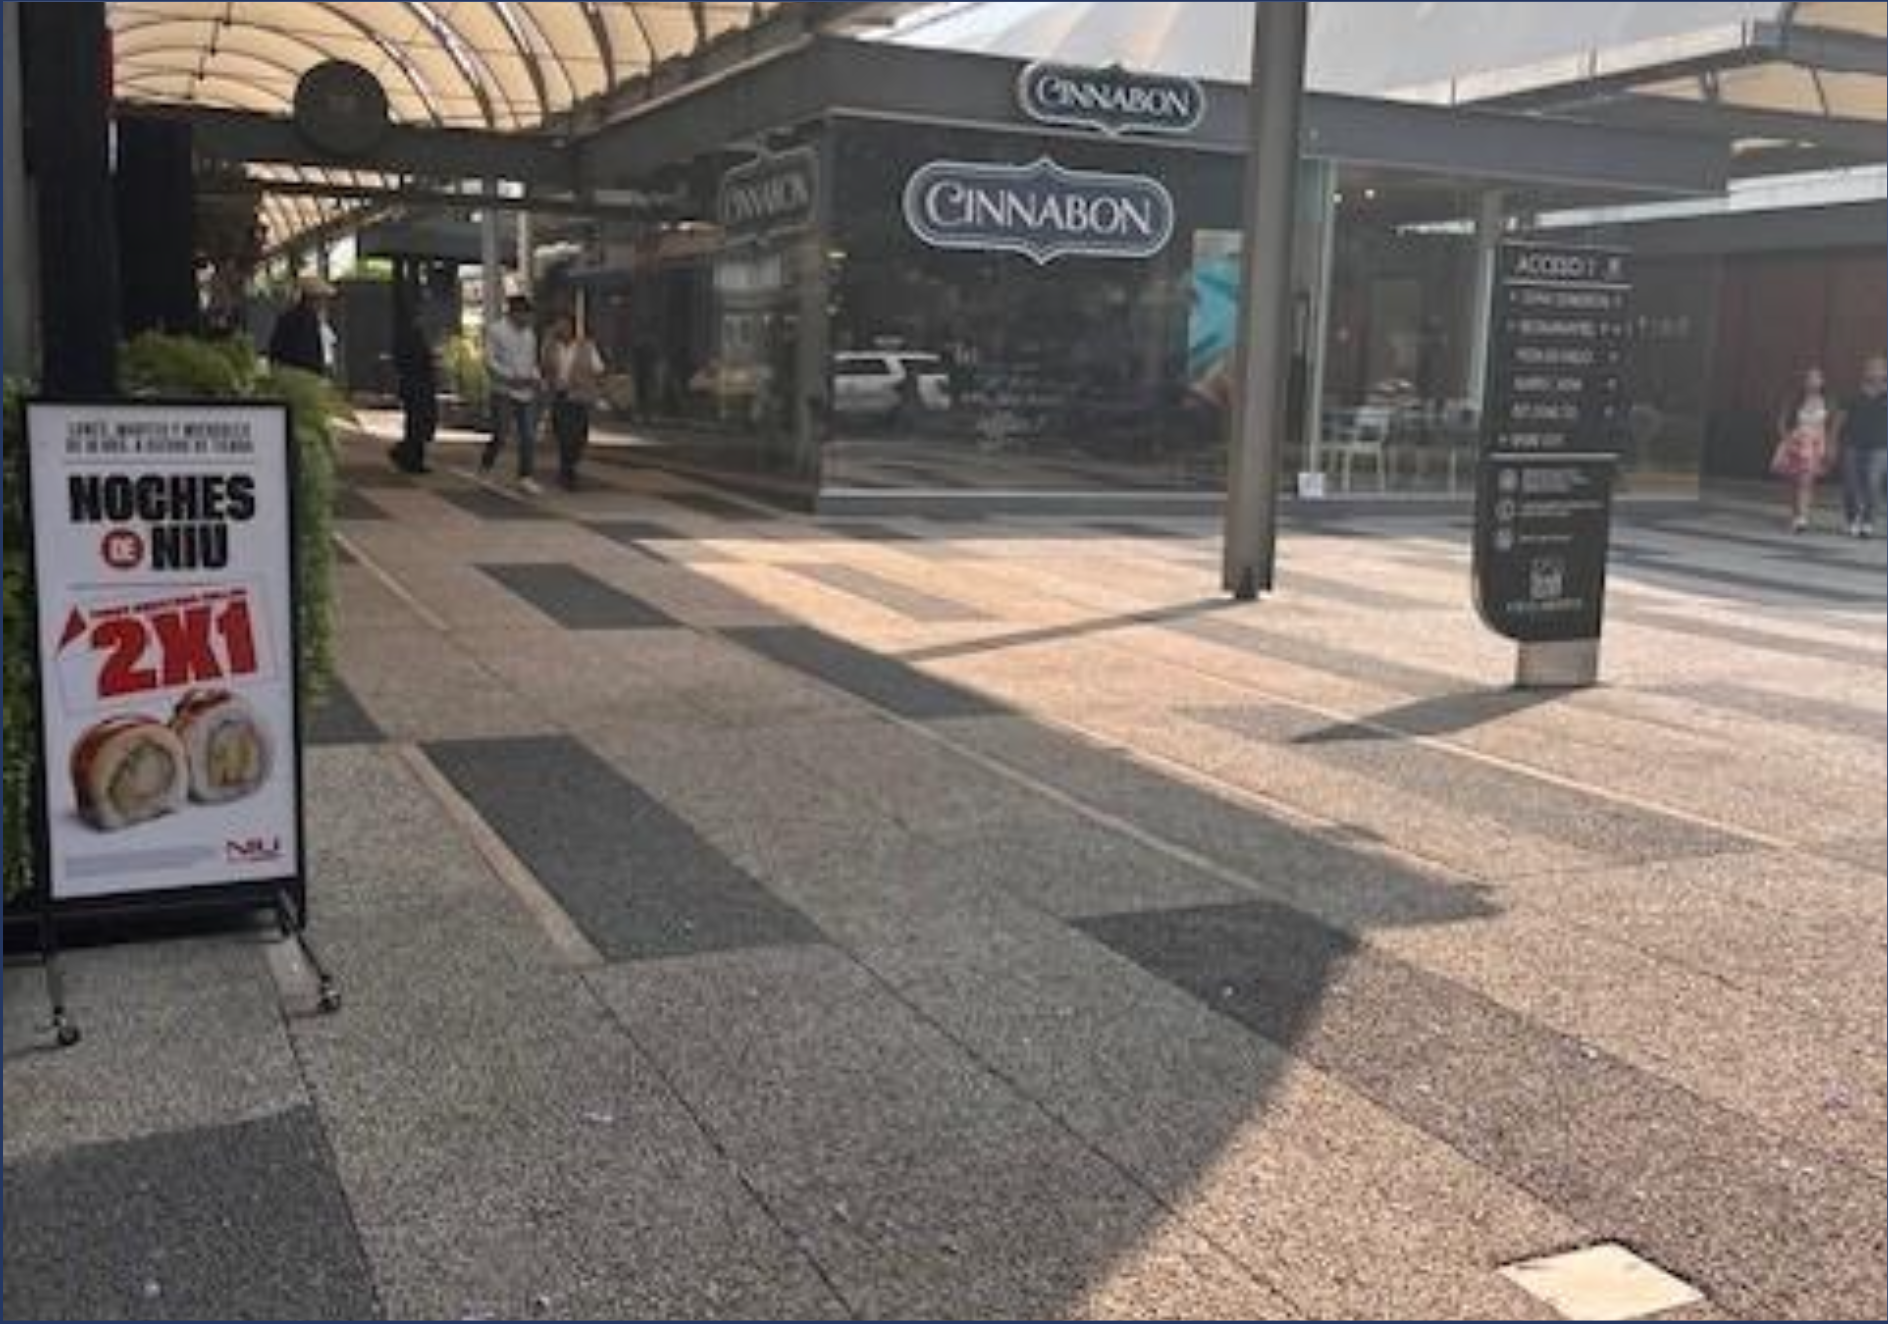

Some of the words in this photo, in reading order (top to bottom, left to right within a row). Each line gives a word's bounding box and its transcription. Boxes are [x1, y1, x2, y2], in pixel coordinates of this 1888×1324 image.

[1036, 75, 1191, 116] CINNABON
[925, 180, 1151, 235] CINNABON
[68, 473, 256, 523] NOCHES
[151, 523, 228, 570] NIU
[91, 600, 257, 696] 2X1
